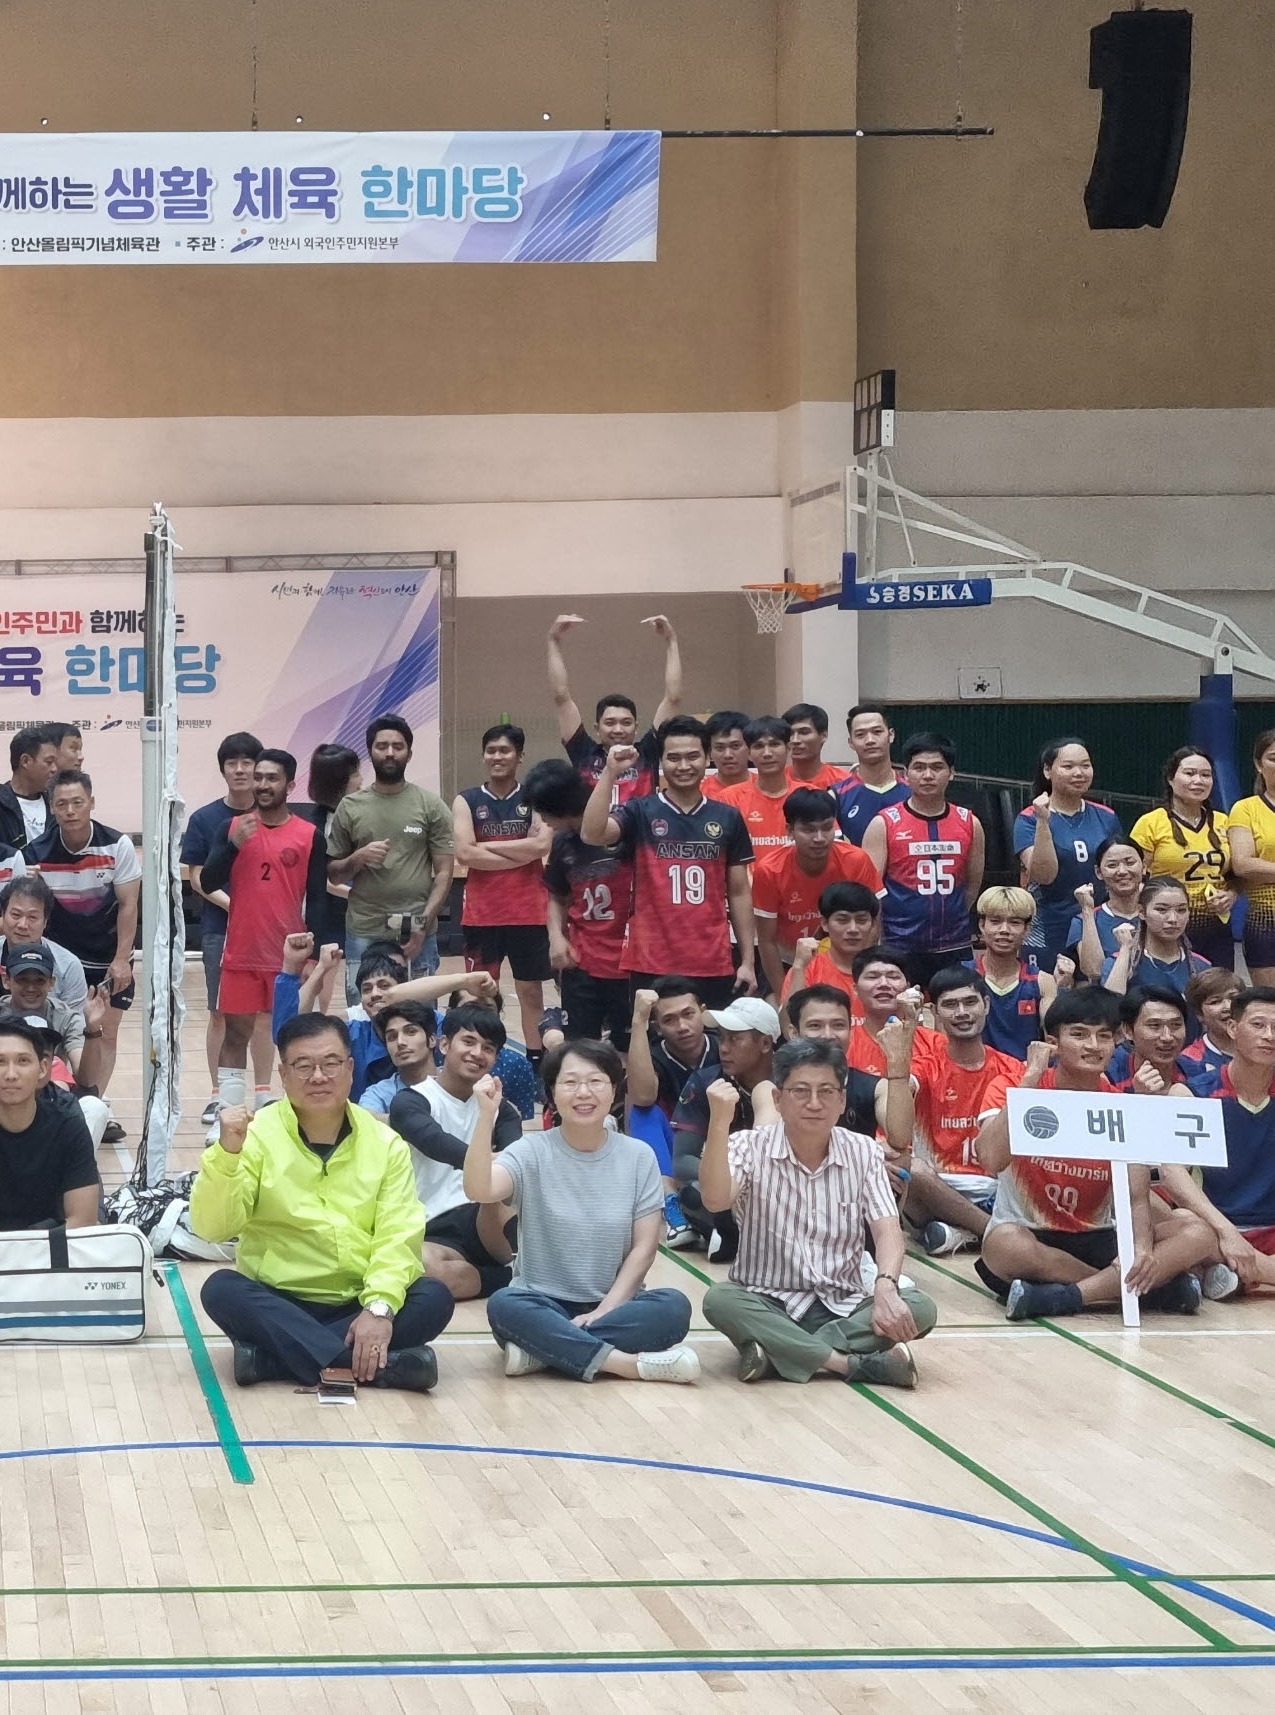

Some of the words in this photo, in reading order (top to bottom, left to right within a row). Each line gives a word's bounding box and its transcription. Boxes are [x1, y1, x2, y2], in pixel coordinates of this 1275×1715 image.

[104, 166, 212, 221] 생활
[232, 166, 337, 220] 체육
[360, 165, 524, 220] 한마당
[11, 237, 161, 253] 안산올림픽기념체육관
[186, 236, 216, 252] 주관
[268, 236, 301, 251] 안산시
[303, 236, 400, 251] 외국인주민지원본부
[394, 583, 420, 597] 안산
[404, 825, 423, 835] Jeep
[481, 822, 529, 837] ANSAN
[655, 842, 721, 860] ANSAN
[1073, 840, 1089, 863] 8
[261, 862, 271, 881] 2
[1182, 850, 1227, 881] 29
[668, 864, 705, 905] 19
[917, 859, 955, 896] 95
[582, 883, 616, 921] 12
[100, 1281, 127, 1291] YONEX
